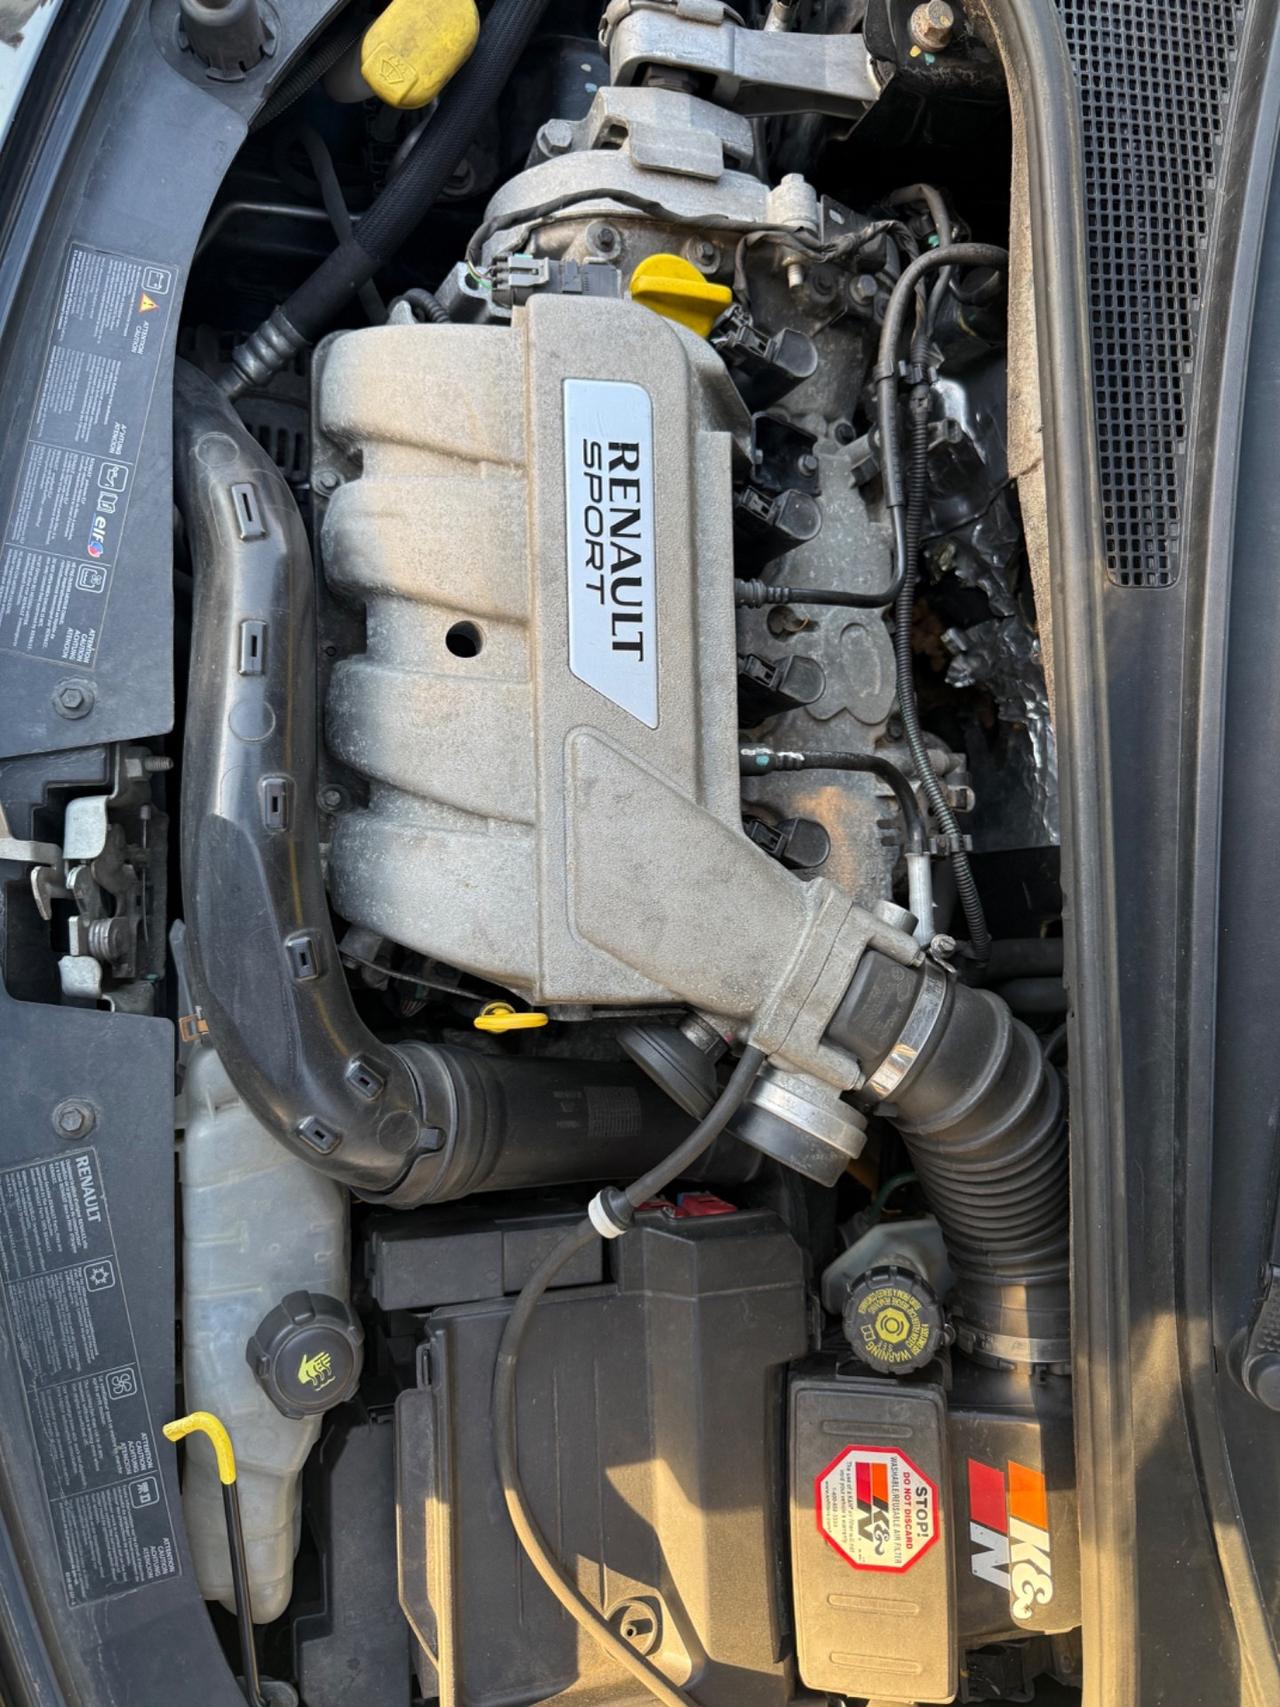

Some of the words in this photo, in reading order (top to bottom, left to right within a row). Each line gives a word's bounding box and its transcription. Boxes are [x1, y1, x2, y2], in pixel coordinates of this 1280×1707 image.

[91, 516, 107, 542] elf
[583, 439, 604, 605] SPORT
[608, 442, 644, 662] RENAULT
[76, 1155, 100, 1223] RENAULT
[866, 1341, 911, 1363] WARNING
[136, 1441, 145, 1469] CAUTION
[141, 1432, 152, 1467] ATTENTION
[890, 1456, 900, 1527] WASHABLE/REUSABLE
[903, 1472, 910, 1485] DO
[916, 1487, 929, 1537] STOP!
[894, 1543, 902, 1564] FILTER
